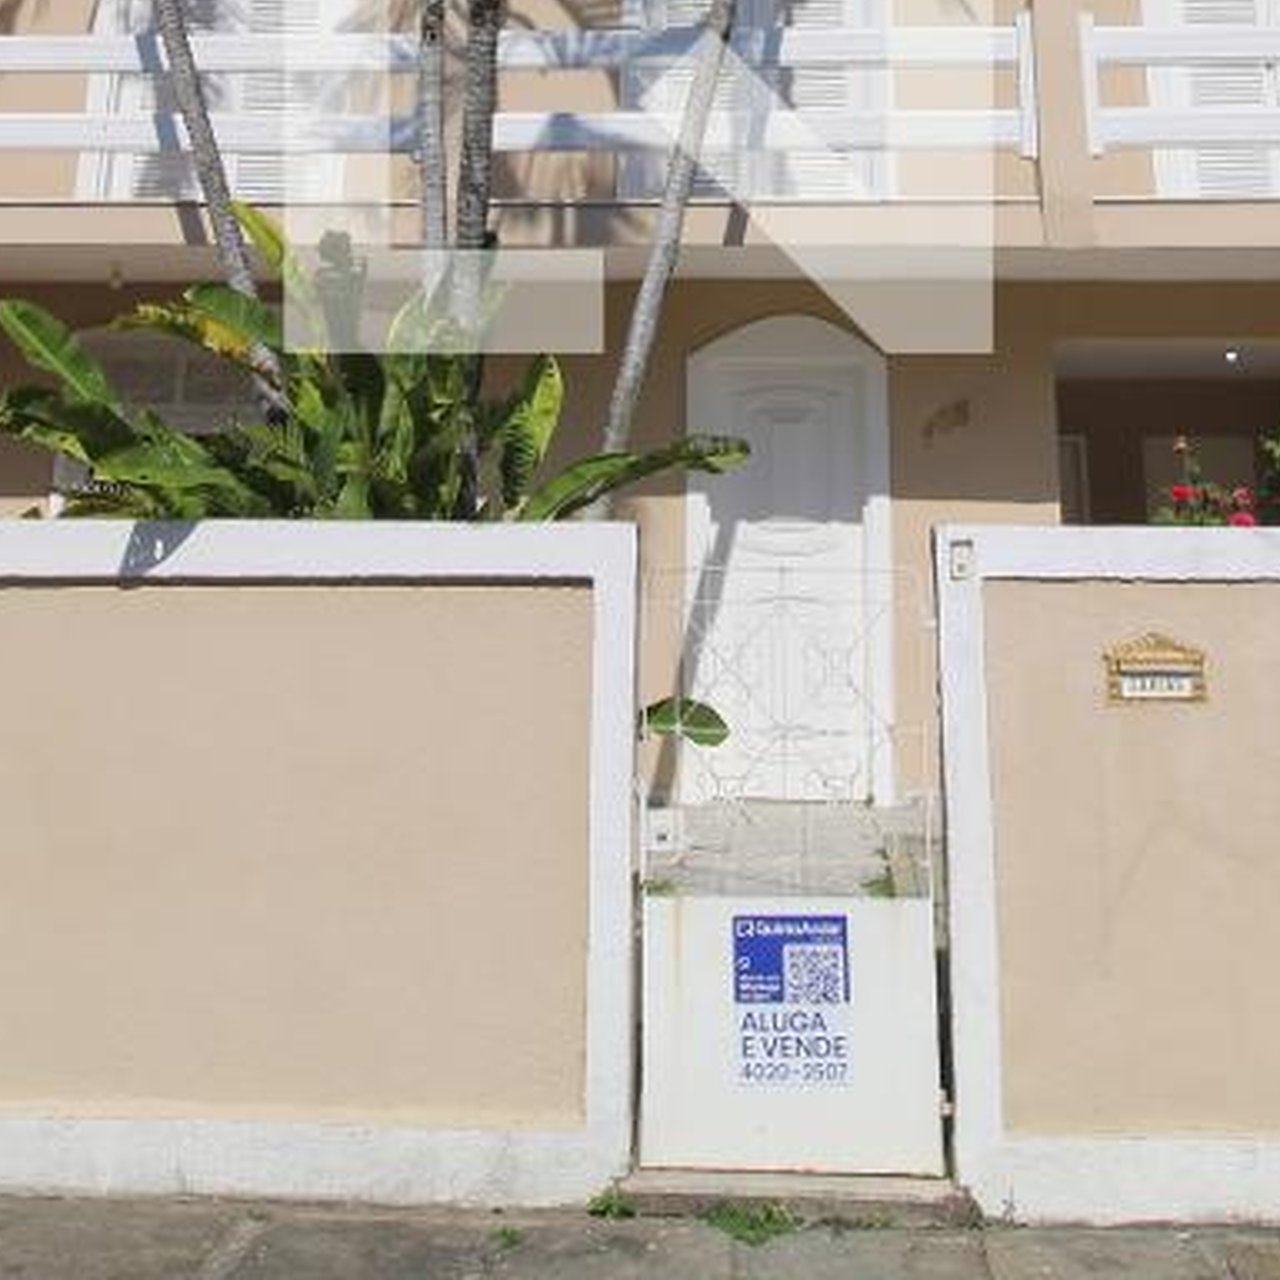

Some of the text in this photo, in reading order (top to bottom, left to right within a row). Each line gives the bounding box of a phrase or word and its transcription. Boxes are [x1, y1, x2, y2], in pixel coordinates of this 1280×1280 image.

[741, 1012, 828, 1033] ALUGA
[742, 1036, 848, 1058] E VENDE
